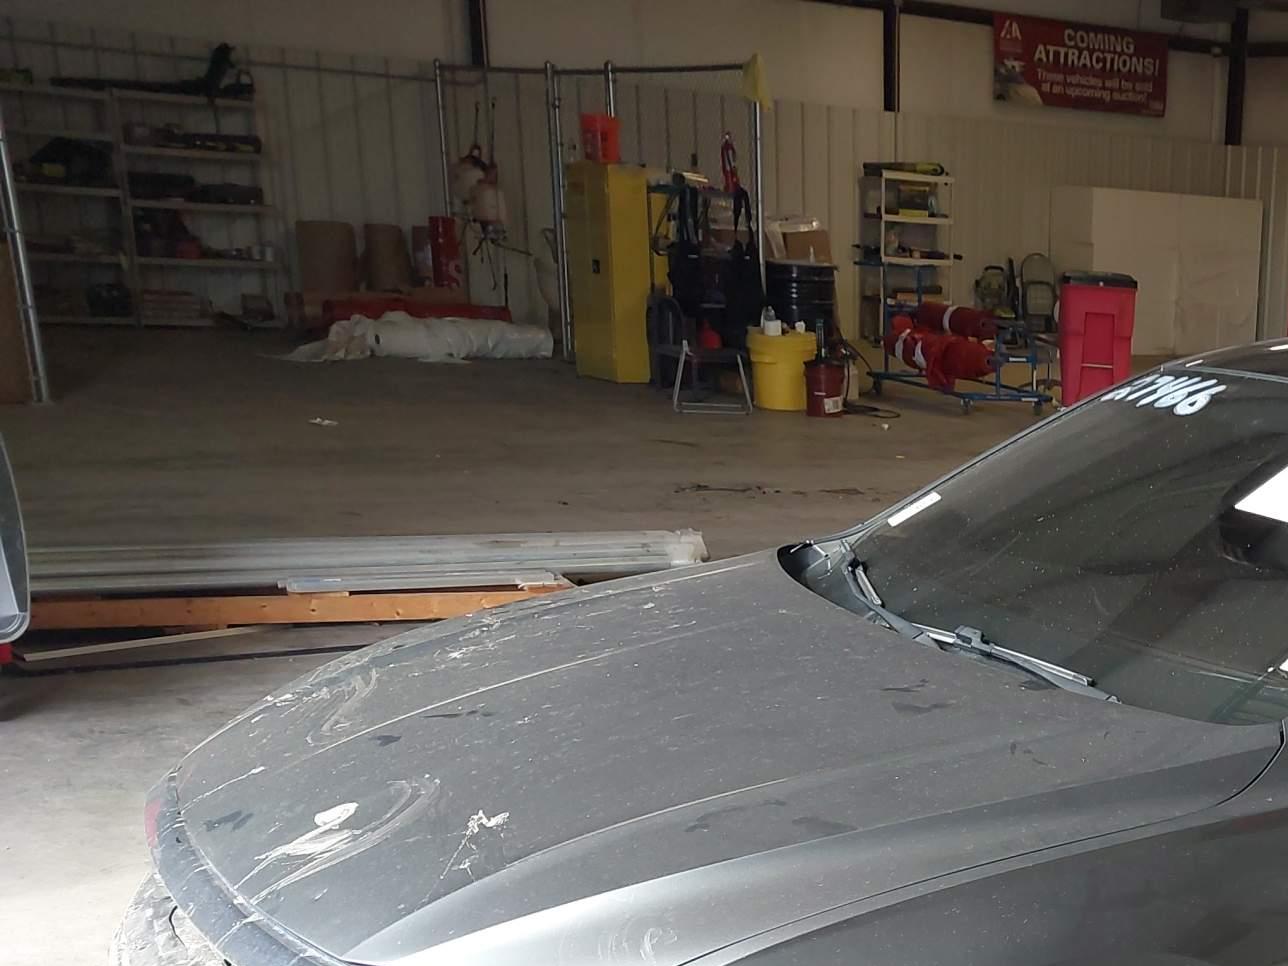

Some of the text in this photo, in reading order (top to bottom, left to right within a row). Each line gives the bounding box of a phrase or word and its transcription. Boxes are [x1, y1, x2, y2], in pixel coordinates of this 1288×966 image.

[1064, 28, 1135, 53] COMING
[1034, 44, 1159, 76] ATTRACTIONS!
[1065, 85, 1111, 102] upcoming
